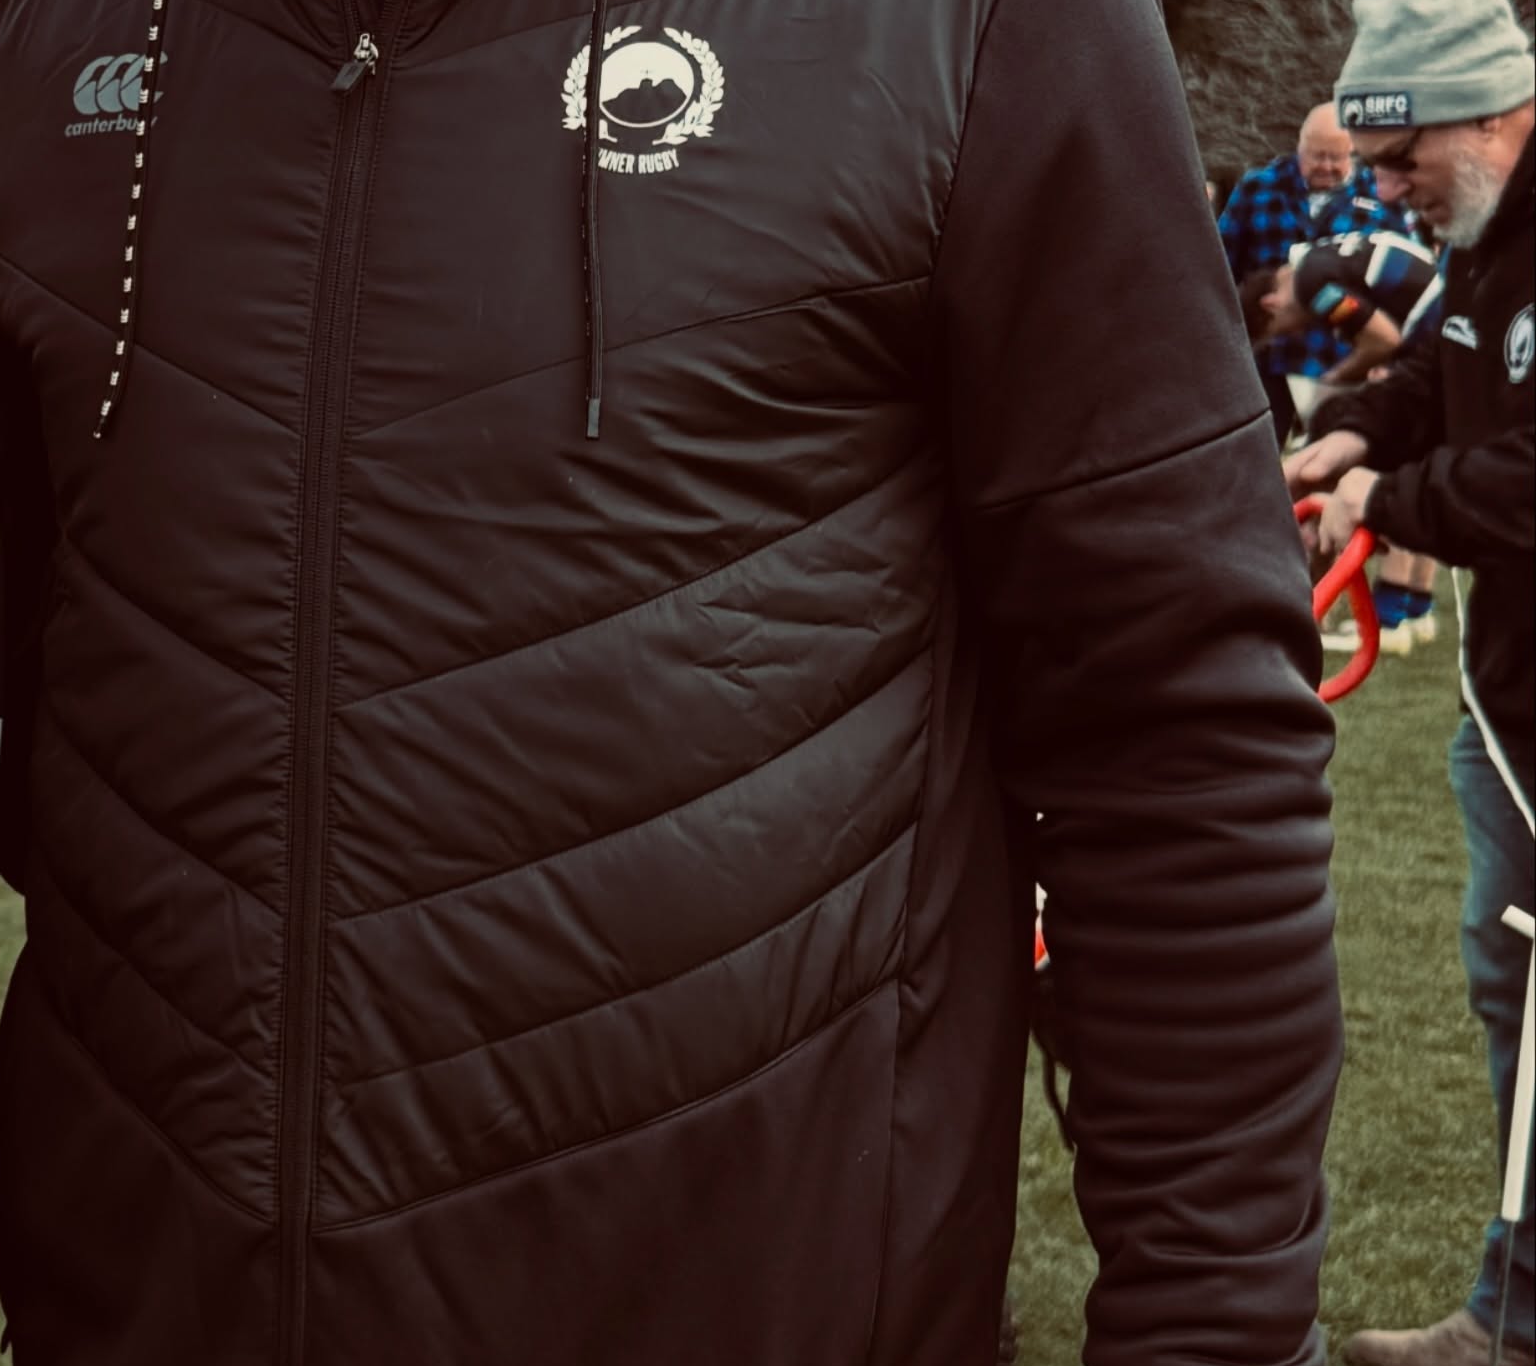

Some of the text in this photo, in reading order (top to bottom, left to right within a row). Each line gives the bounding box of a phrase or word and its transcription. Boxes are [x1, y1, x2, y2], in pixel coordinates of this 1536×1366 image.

[65, 114, 158, 137] canterbu
[598, 146, 680, 174] MNER RUGBY
